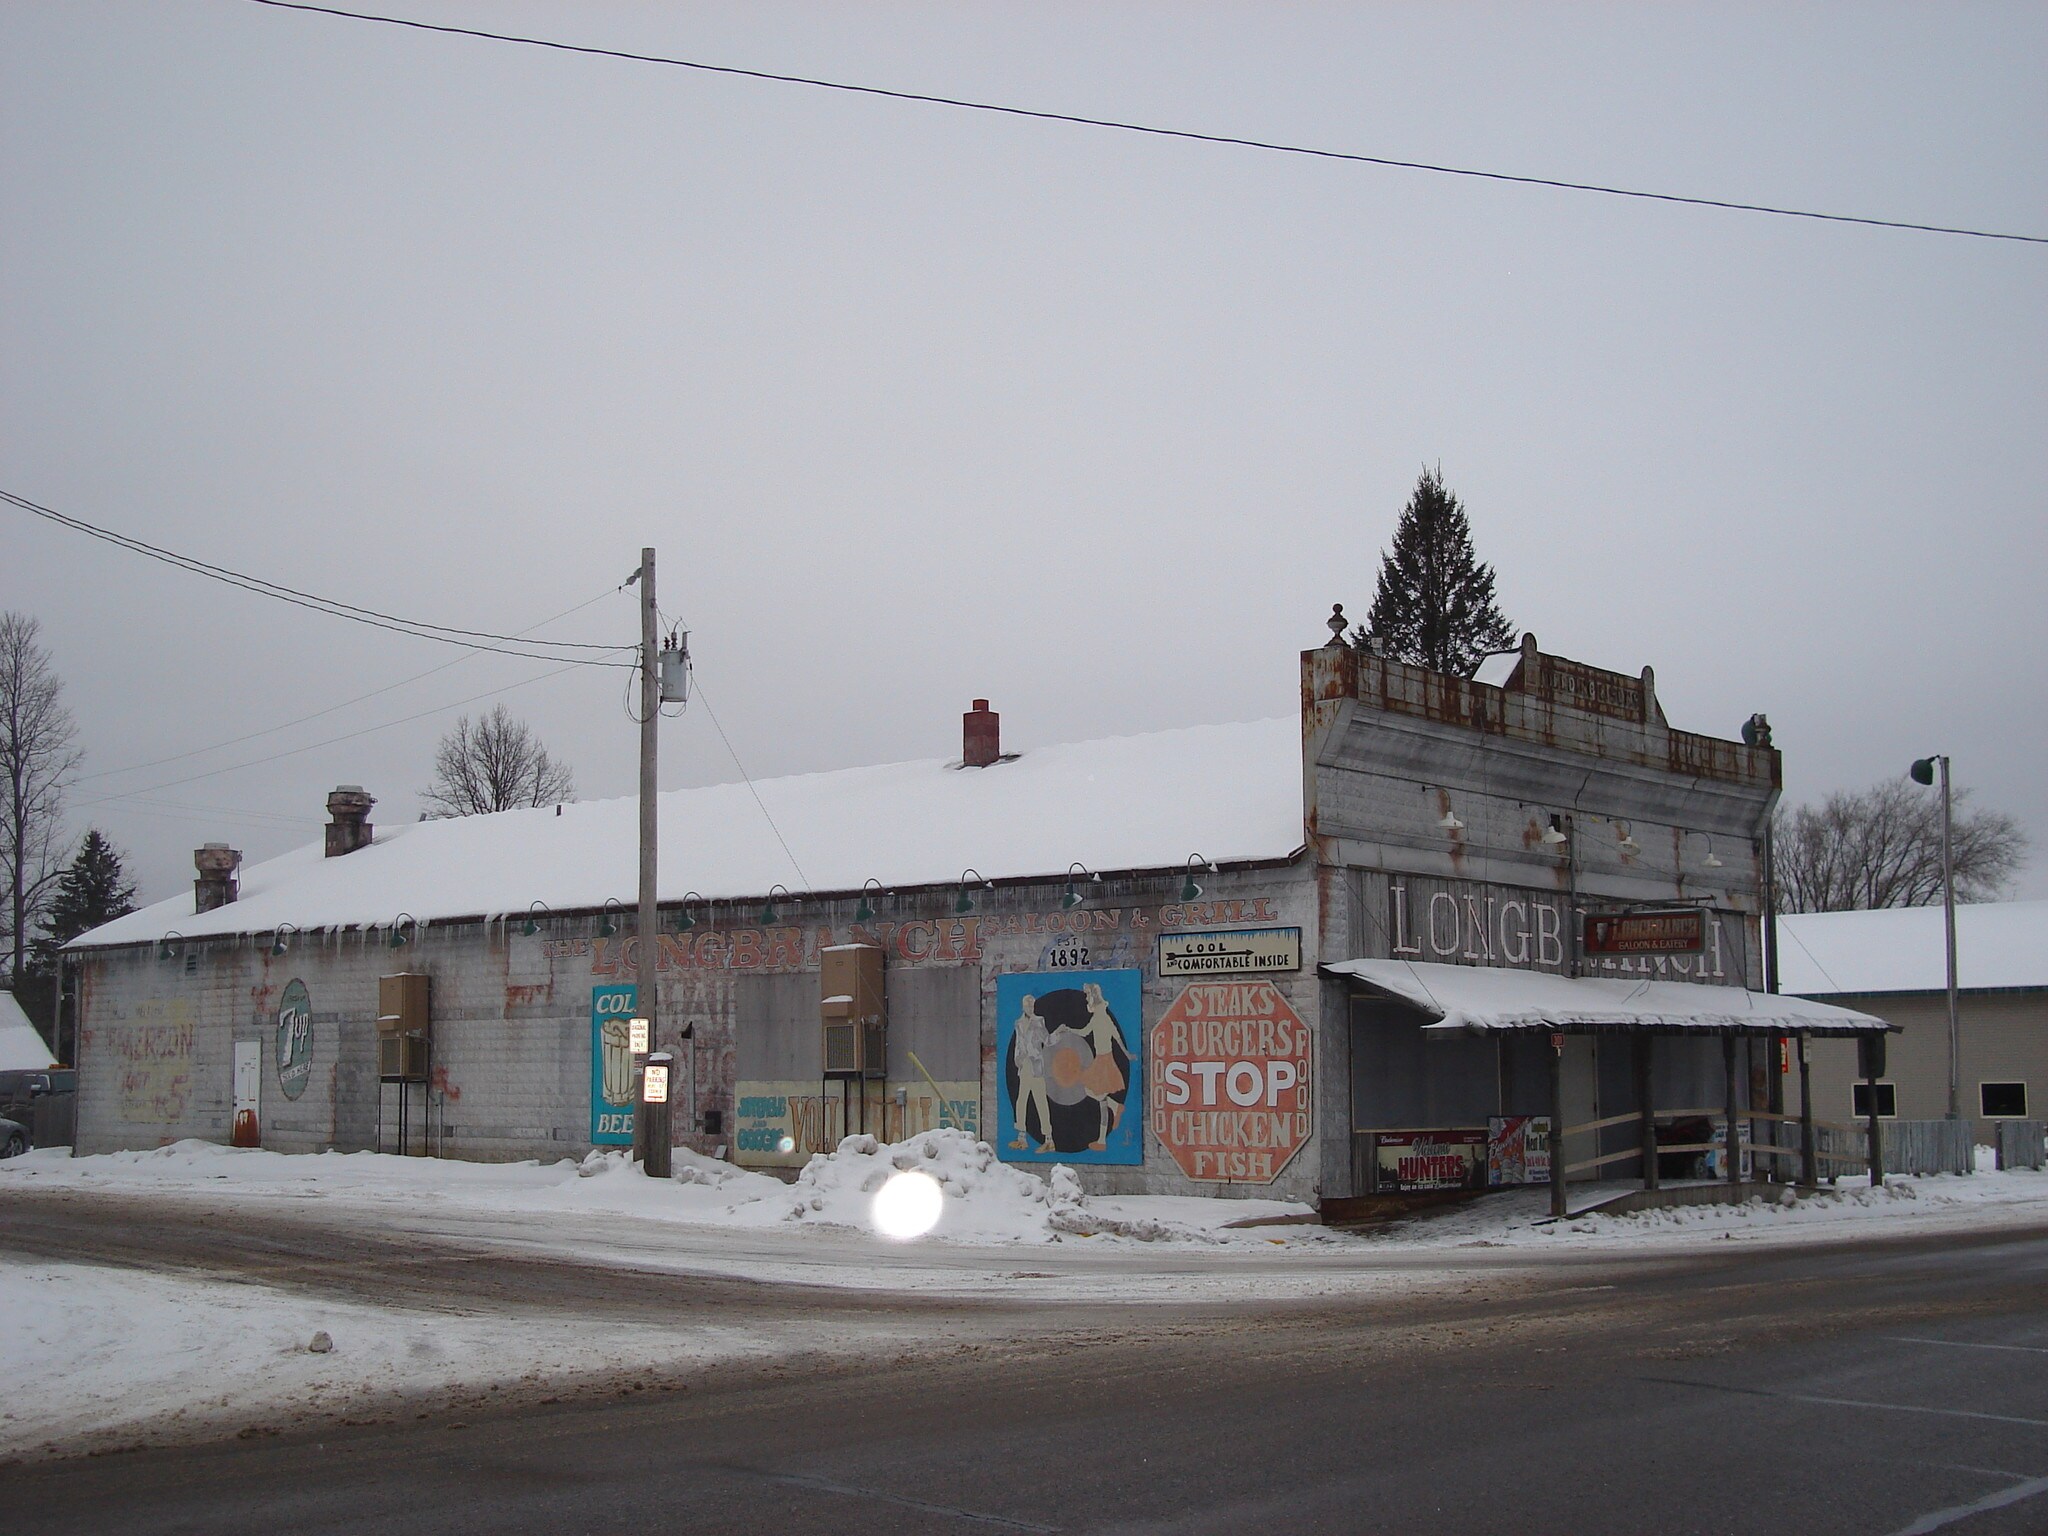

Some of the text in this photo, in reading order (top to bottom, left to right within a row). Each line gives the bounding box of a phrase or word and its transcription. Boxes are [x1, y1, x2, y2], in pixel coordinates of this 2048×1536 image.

[542, 939, 589, 958] THE
[981, 909, 1122, 936] SALOON
[1130, 907, 1149, 928] &
[1158, 897, 1278, 927] GRILL
[1390, 886, 1724, 977] LONGBH
[1057, 937, 1079, 946] EST
[1186, 942, 1226, 953] COOL
[1618, 939, 1688, 950] SALOON & EATERY
[1050, 947, 1090, 967] 1892
[1177, 955, 1250, 970] COMFORTABLE
[1254, 954, 1289, 967] INSIDE
[596, 993, 637, 1014] COL
[1185, 986, 1275, 1017] STEAKS
[1171, 1019, 1293, 1057] BURGERS
[646, 1076, 667, 1084] PARKING
[1165, 1060, 1297, 1107] STOP
[940, 1101, 976, 1119] LIVE
[597, 1113, 635, 1134] BEE
[1171, 1110, 1293, 1148] CHICKEN
[1194, 1151, 1274, 1178] FISH
[1398, 1154, 1465, 1180] HUNTERS
